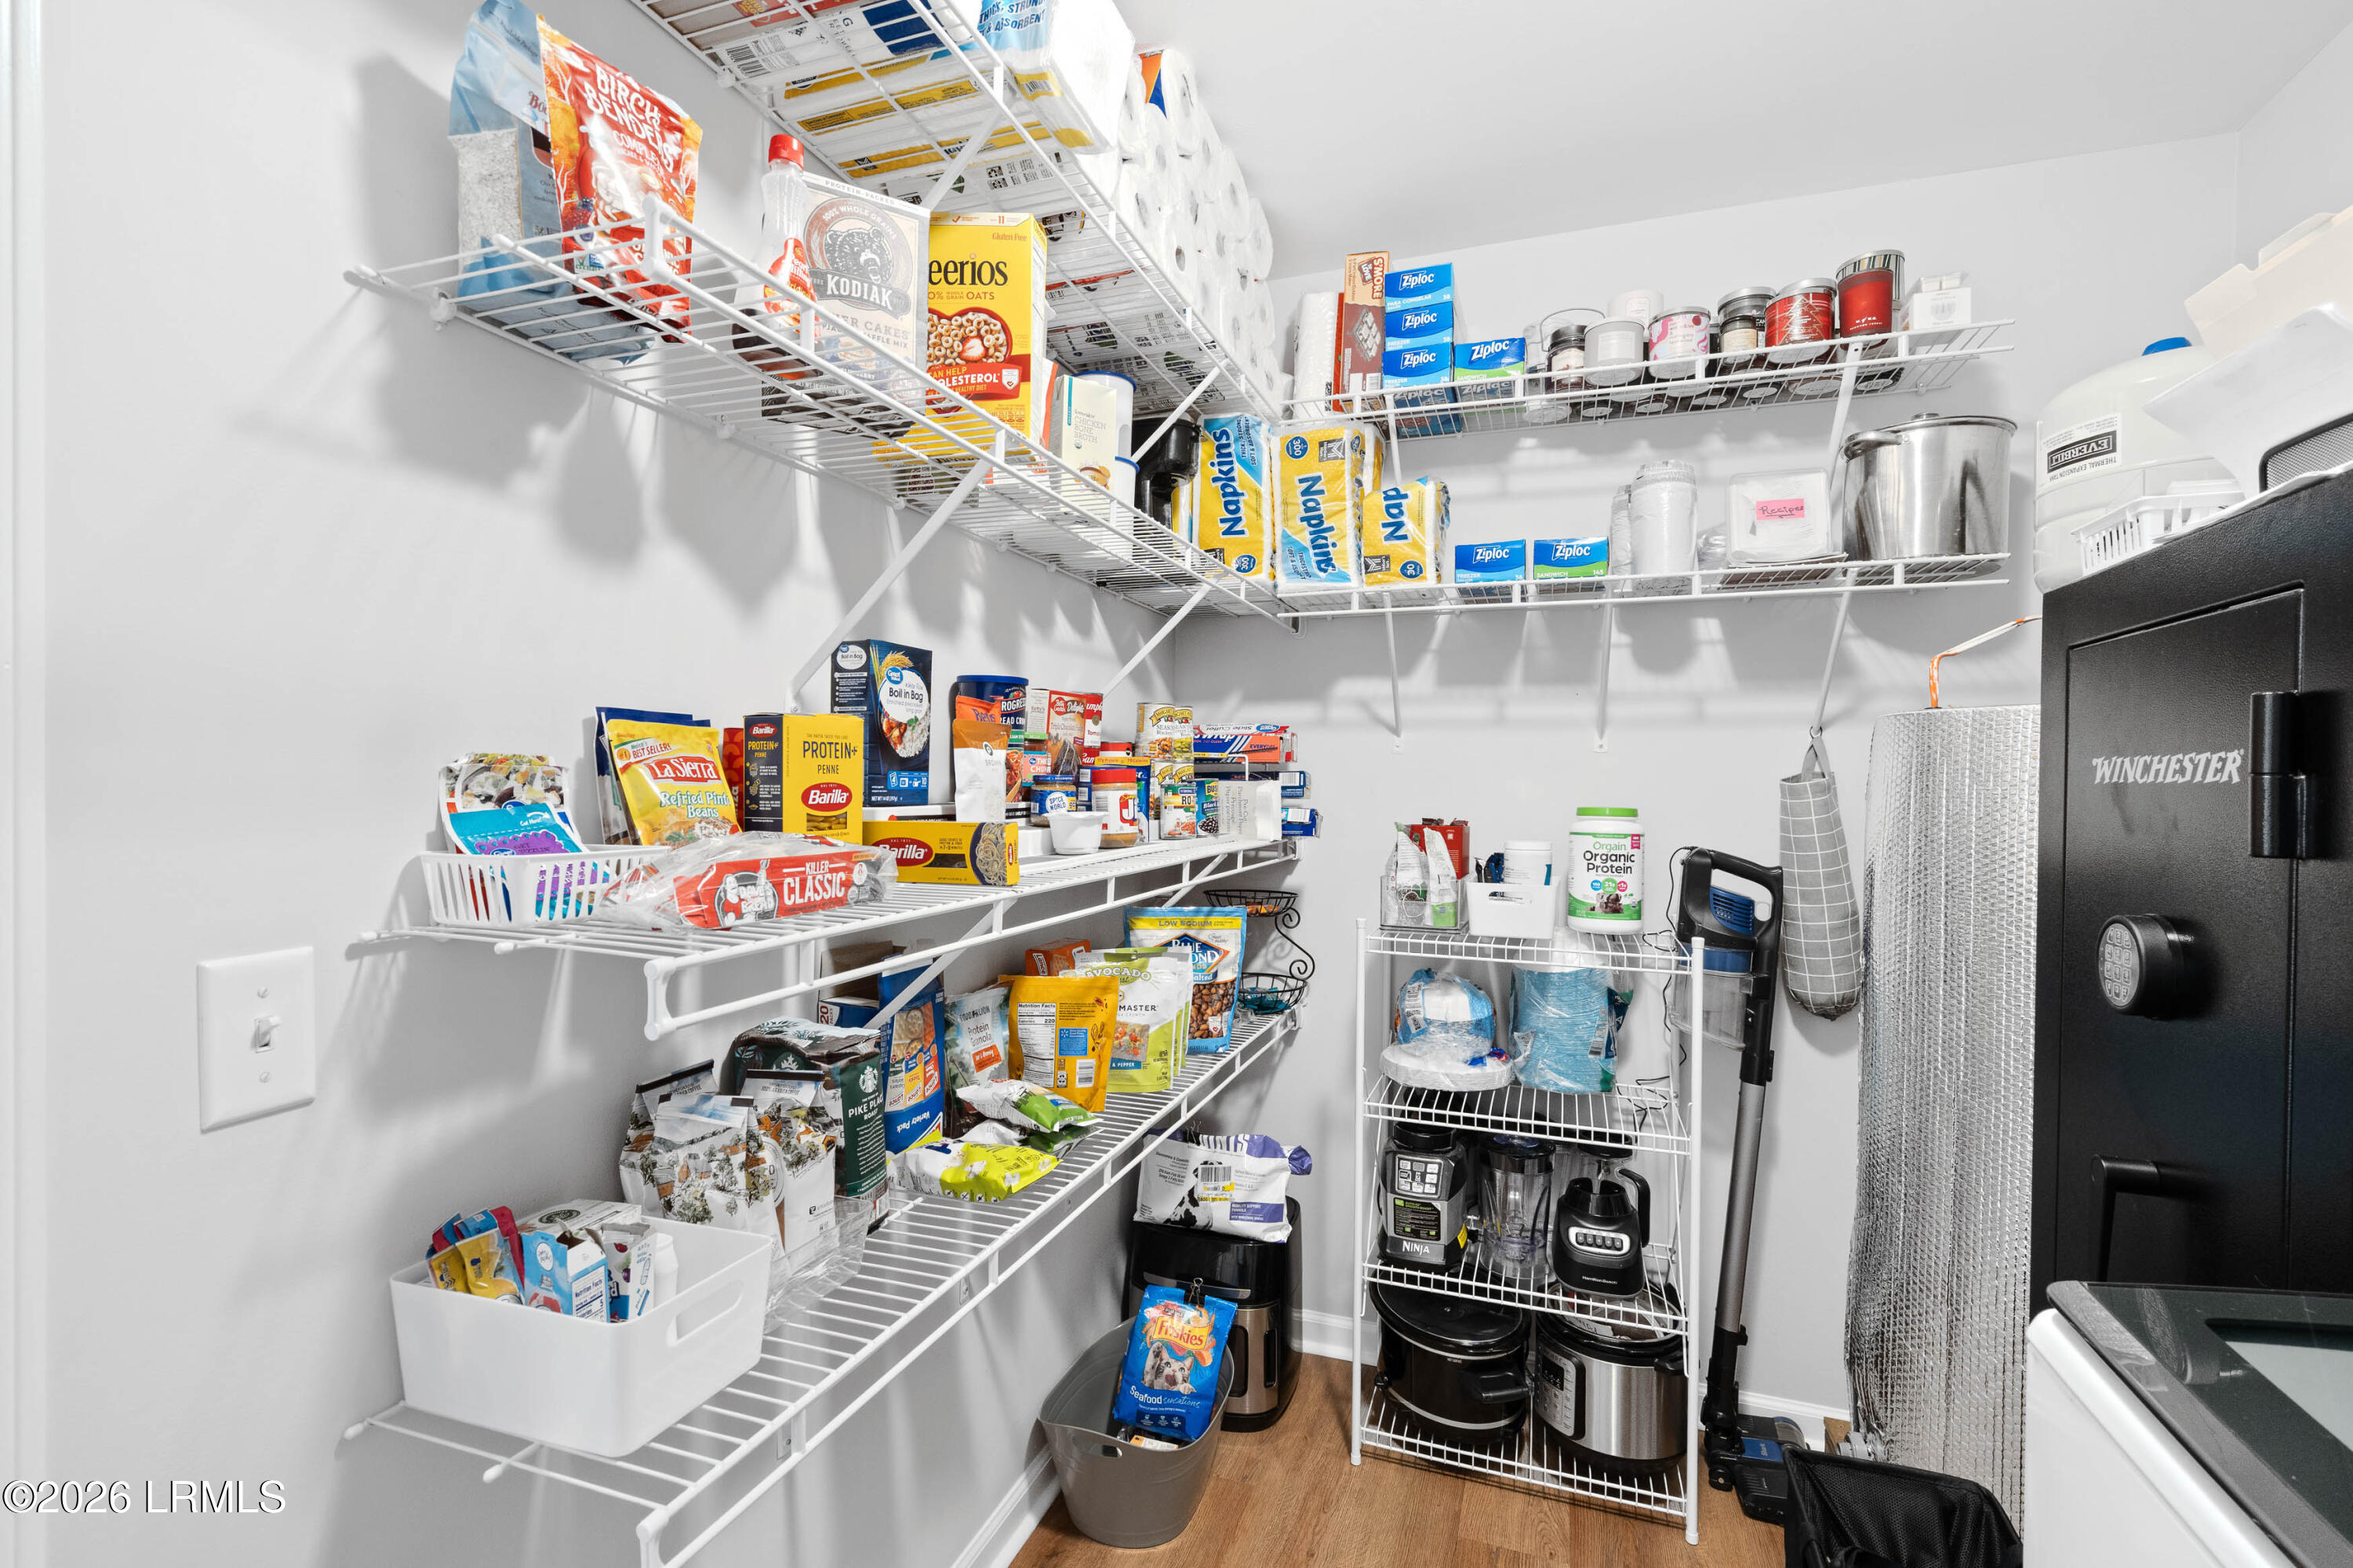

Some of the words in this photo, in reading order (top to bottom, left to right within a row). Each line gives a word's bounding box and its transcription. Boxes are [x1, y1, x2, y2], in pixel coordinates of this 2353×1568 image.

[596, 64, 660, 125] BIRCH
[840, 205, 869, 216] WHOLE
[992, 232, 1013, 242] Gluten
[1014, 233, 1027, 242] Free
[929, 253, 1009, 286] eerios
[1402, 272, 1435, 289] Ziploc
[827, 274, 893, 311] KODIAK
[966, 291, 995, 300] OATS
[1404, 313, 1438, 329] Ziploc
[864, 321, 909, 340] CAKES
[1471, 340, 1510, 361] Ziploc
[1402, 352, 1436, 368] Ziploc
[946, 366, 967, 376] HELP
[939, 373, 998, 387] OLESTEROL
[1293, 438, 1301, 457] 300
[2050, 438, 2109, 466] EVERBILT
[2089, 456, 2117, 467] THERMAL
[2060, 464, 2087, 478] EXPANSION
[1209, 428, 1246, 537] Napkins
[1758, 506, 1804, 516] Recipes
[1298, 475, 1338, 574] Napkins
[1475, 548, 1510, 563] Ziploc
[1555, 545, 1591, 560] Ziploc
[889, 688, 903, 697] Boil
[904, 689, 910, 697] in
[911, 691, 923, 704] Bag
[632, 748, 646, 759] BEST
[646, 742, 672, 755] SELLER!
[651, 762, 675, 778] La
[673, 758, 717, 779] Sierra
[817, 764, 839, 774] PENNE
[2092, 749, 2242, 784] WINCHESTER
[1206, 784, 1218, 793] BUS
[660, 791, 703, 807] Refried
[808, 789, 849, 805] Barilla
[687, 805, 719, 818] Beans
[1049, 802, 1067, 811] WORLD
[1593, 841, 1627, 853] Orgain
[1583, 849, 1635, 864] Organic
[806, 860, 829, 875] KILLER
[1587, 862, 1632, 874] Protein
[784, 871, 846, 906] CLASSIC
[1035, 954, 1046, 975] Lance
[1086, 966, 1151, 981] AVOCADO
[820, 1005, 829, 1024] 20
[978, 1005, 991, 1017] LION
[967, 1022, 989, 1037] Protein
[971, 1032, 992, 1046] Granola
[926, 1076, 937, 1093] Lance
[889, 1093, 904, 1107] Lance
[907, 1086, 922, 1102] Lance
[848, 1103, 867, 1118] PIKE
[869, 1095, 884, 1108] PLAC
[864, 1108, 878, 1121] ROAST
[911, 1111, 930, 1124] Variety
[896, 1120, 910, 1133] Pack
[1402, 1240, 1430, 1256] NINJA
[1158, 1319, 1205, 1346] Friskies
[1129, 1385, 1162, 1404] Seafood
[1162, 1395, 1202, 1409] sensations
